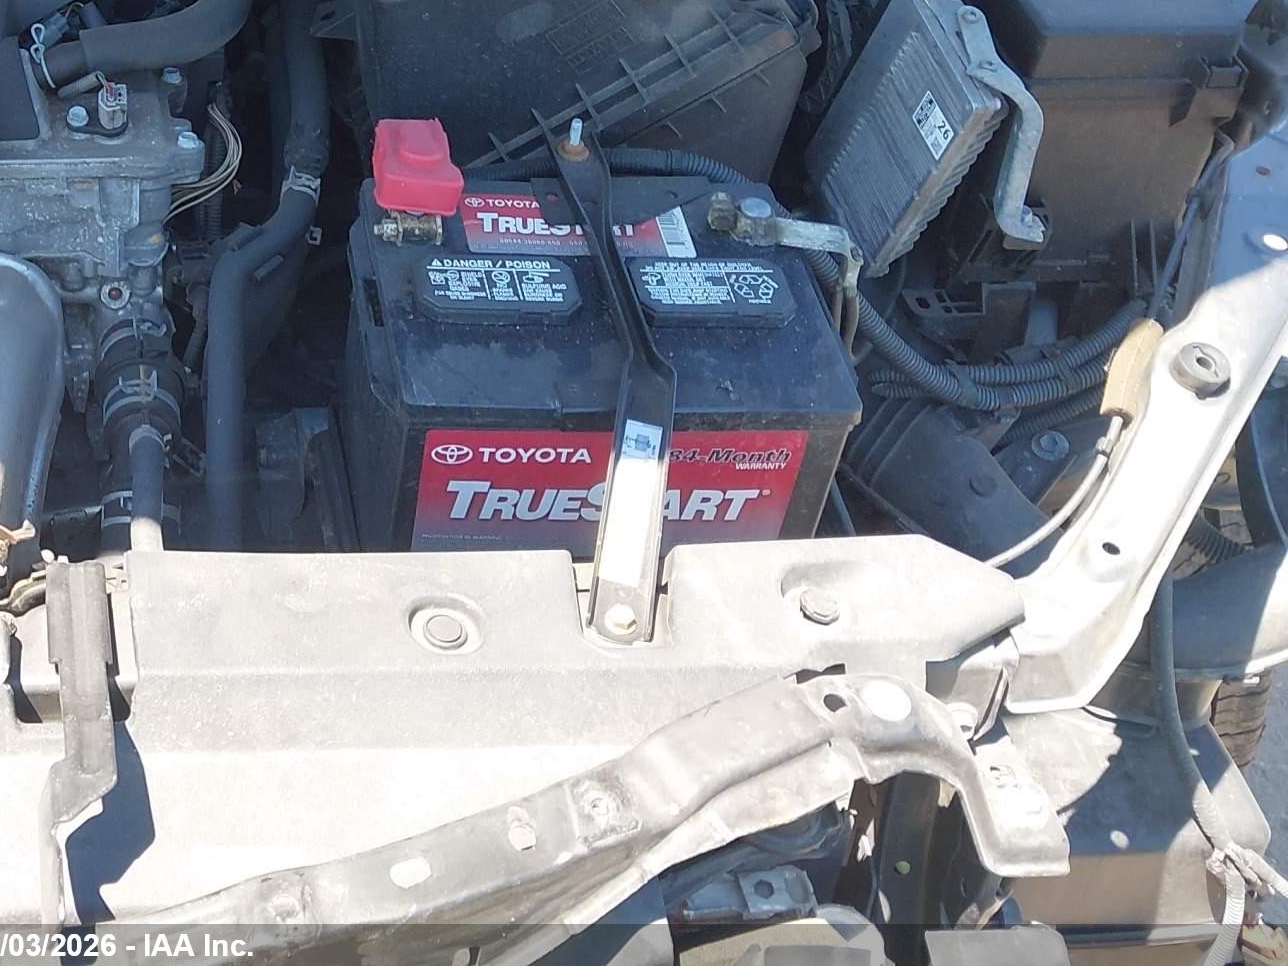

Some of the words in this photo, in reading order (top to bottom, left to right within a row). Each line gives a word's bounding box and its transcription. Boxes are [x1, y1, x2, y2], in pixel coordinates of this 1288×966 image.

[937, 120, 951, 140] 26
[486, 199, 540, 209] TOYOTA
[443, 259, 493, 268] DANGER
[505, 260, 551, 269] POISON
[478, 447, 592, 464] TOYOTA
[735, 462, 787, 470] WARRANTY
